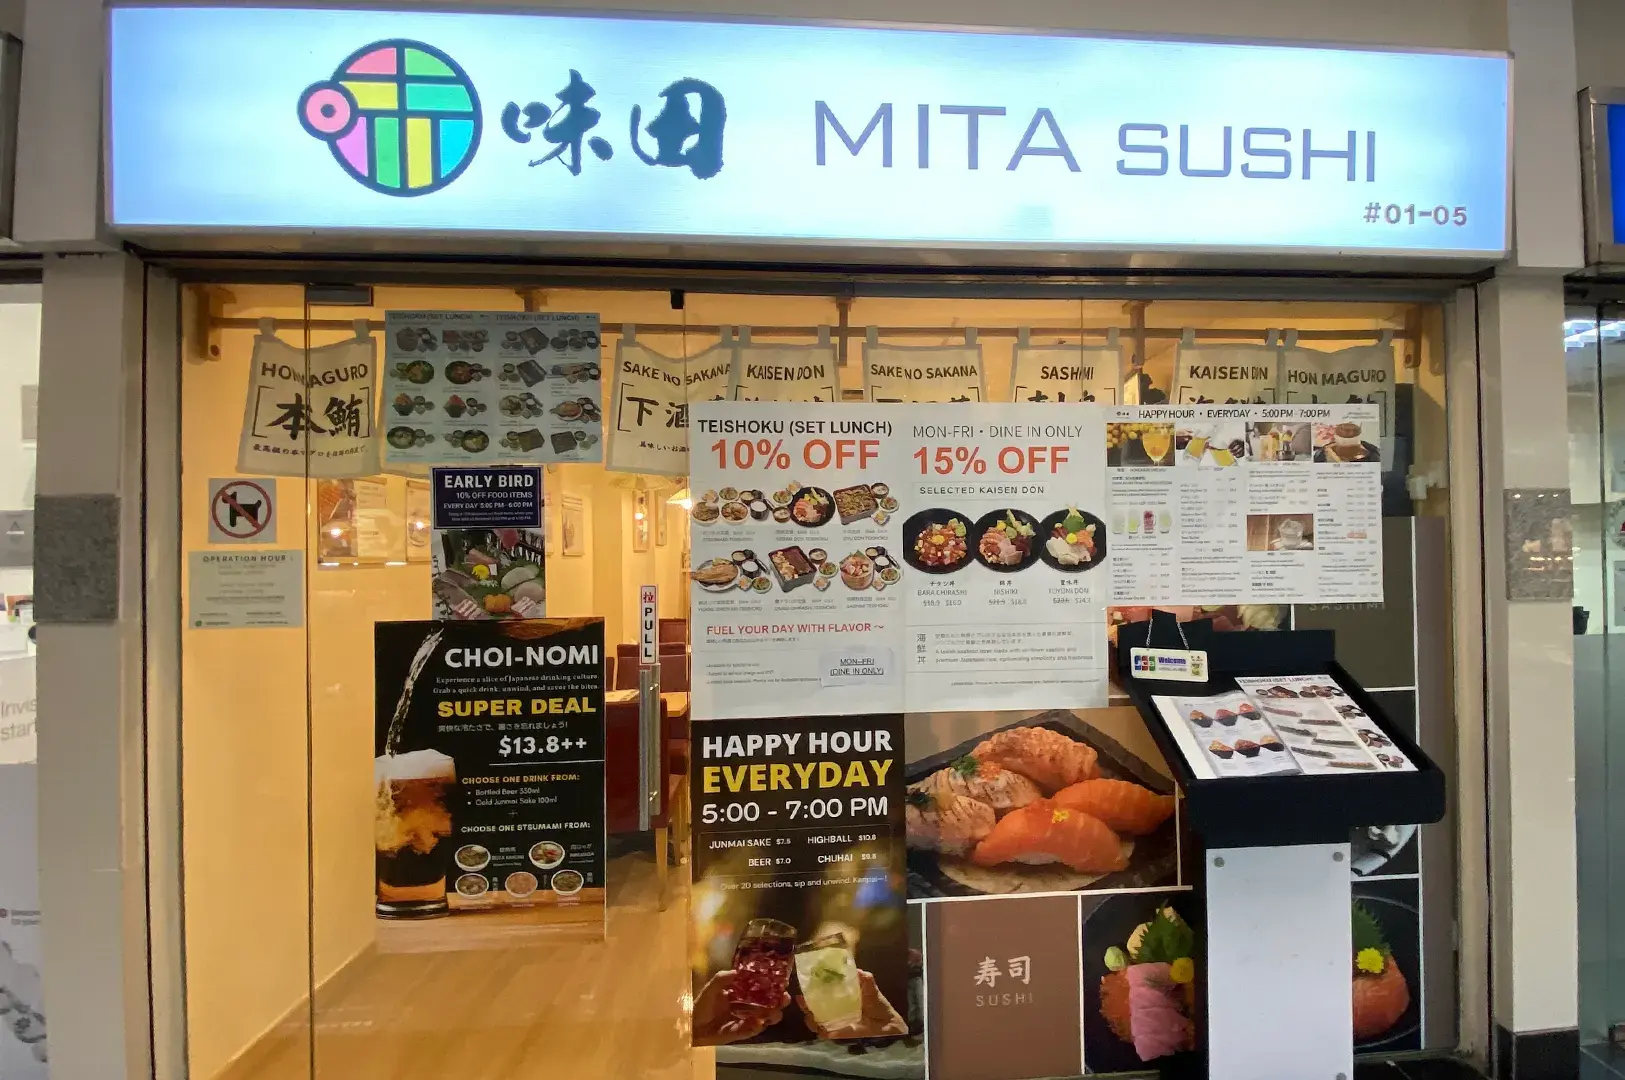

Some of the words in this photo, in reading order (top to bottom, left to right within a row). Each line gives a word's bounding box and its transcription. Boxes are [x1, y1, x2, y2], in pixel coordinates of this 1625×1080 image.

[815, 100, 1082, 172] MITA
[1116, 122, 1376, 183] SUSHI
[1363, 201, 1468, 226] #01-05
[622, 361, 659, 380] SAKE
[663, 371, 681, 386] NO
[686, 363, 731, 385] SAKANA
[746, 363, 794, 381] KAISEN
[796, 364, 825, 381] DON
[870, 363, 903, 378] SAKE
[904, 368, 922, 380] NO
[926, 364, 978, 379] SAKANA
[1189, 365, 1249, 381] KAISEN
[1287, 370, 1318, 386] HON
[1321, 369, 1387, 387] MAGURO
[266, 393, 363, 440] 本鮪
[1138, 409, 1168, 419] HAPPY
[1168, 409, 1195, 418] HOUR
[1207, 409, 1251, 418] EVERYDAY
[1261, 409, 1279, 418] 5:00
[1280, 409, 1294, 417] PM
[1299, 409, 1316, 418] 7:00
[1317, 409, 1331, 417] PM
[698, 419, 784, 434] TEISHOKU
[789, 421, 826, 437] (SET
[830, 420, 893, 437] LUNCH)
[913, 425, 974, 438] MON-FRI
[989, 425, 1022, 438] DINE
[1027, 425, 1041, 438] IN
[1045, 425, 1083, 438] ONLY
[711, 438, 791, 470] 10%
[803, 438, 880, 470] OFF
[913, 446, 987, 475] 15%
[997, 446, 1070, 475] OFF
[445, 475, 493, 488] EARLY
[498, 475, 534, 488] BIRD
[488, 491, 508, 499] FOOD
[510, 491, 533, 499] ITEMS
[920, 486, 975, 494] SELECTED
[979, 486, 1018, 494] KAISEN
[1021, 485, 1045, 494] DON
[917, 588, 935, 596] BARA
[644, 607, 653, 657] PULL
[707, 625, 735, 635] FUEL
[737, 625, 768, 635] YOUR
[771, 624, 795, 634] DAY
[797, 624, 825, 633] WITH
[828, 622, 871, 633] FLAVOR
[444, 644, 599, 668] CHOI-NOMI
[1158, 656, 1187, 665] Welcome
[436, 676, 476, 684] Experience
[508, 675, 540, 683] Japanese
[540, 674, 572, 682] drinking
[830, 667, 851, 677] (DINE
[852, 667, 860, 676] IN
[861, 666, 884, 676] ONLY)
[457, 687, 478, 695] quick
[437, 699, 522, 717] SUPER
[531, 697, 597, 714] DEAL
[498, 735, 587, 758] $13.8++
[702, 733, 802, 759] HAPPY
[808, 730, 893, 754] HOUR
[462, 776, 500, 785] CHOOSE
[502, 775, 520, 783] ONE
[523, 775, 549, 783] DRINK
[551, 773, 580, 781] FROM:
[703, 759, 894, 794] EVERYDAY
[538, 796, 558, 804] 100ml
[702, 801, 760, 824] 5:00
[785, 798, 843, 820] 7:00
[850, 796, 888, 817] PM
[461, 825, 496, 833] CHOOSE
[498, 824, 515, 832] ONE
[564, 821, 591, 829] FROM:
[709, 840, 746, 850] JUNMAI
[747, 838, 772, 847] SAKE
[807, 835, 853, 844] HIGHBALL
[748, 858, 771, 867] BEER
[775, 857, 791, 865] $7.0
[817, 854, 853, 864] CHUHAI
[720, 883, 739, 891] Over
[741, 882, 752, 890] 20
[753, 880, 793, 889] selections,
[794, 880, 806, 889] sip
[807, 878, 822, 887] and
[974, 955, 1031, 987] 寿司
[976, 992, 1034, 1007] SUSHI
